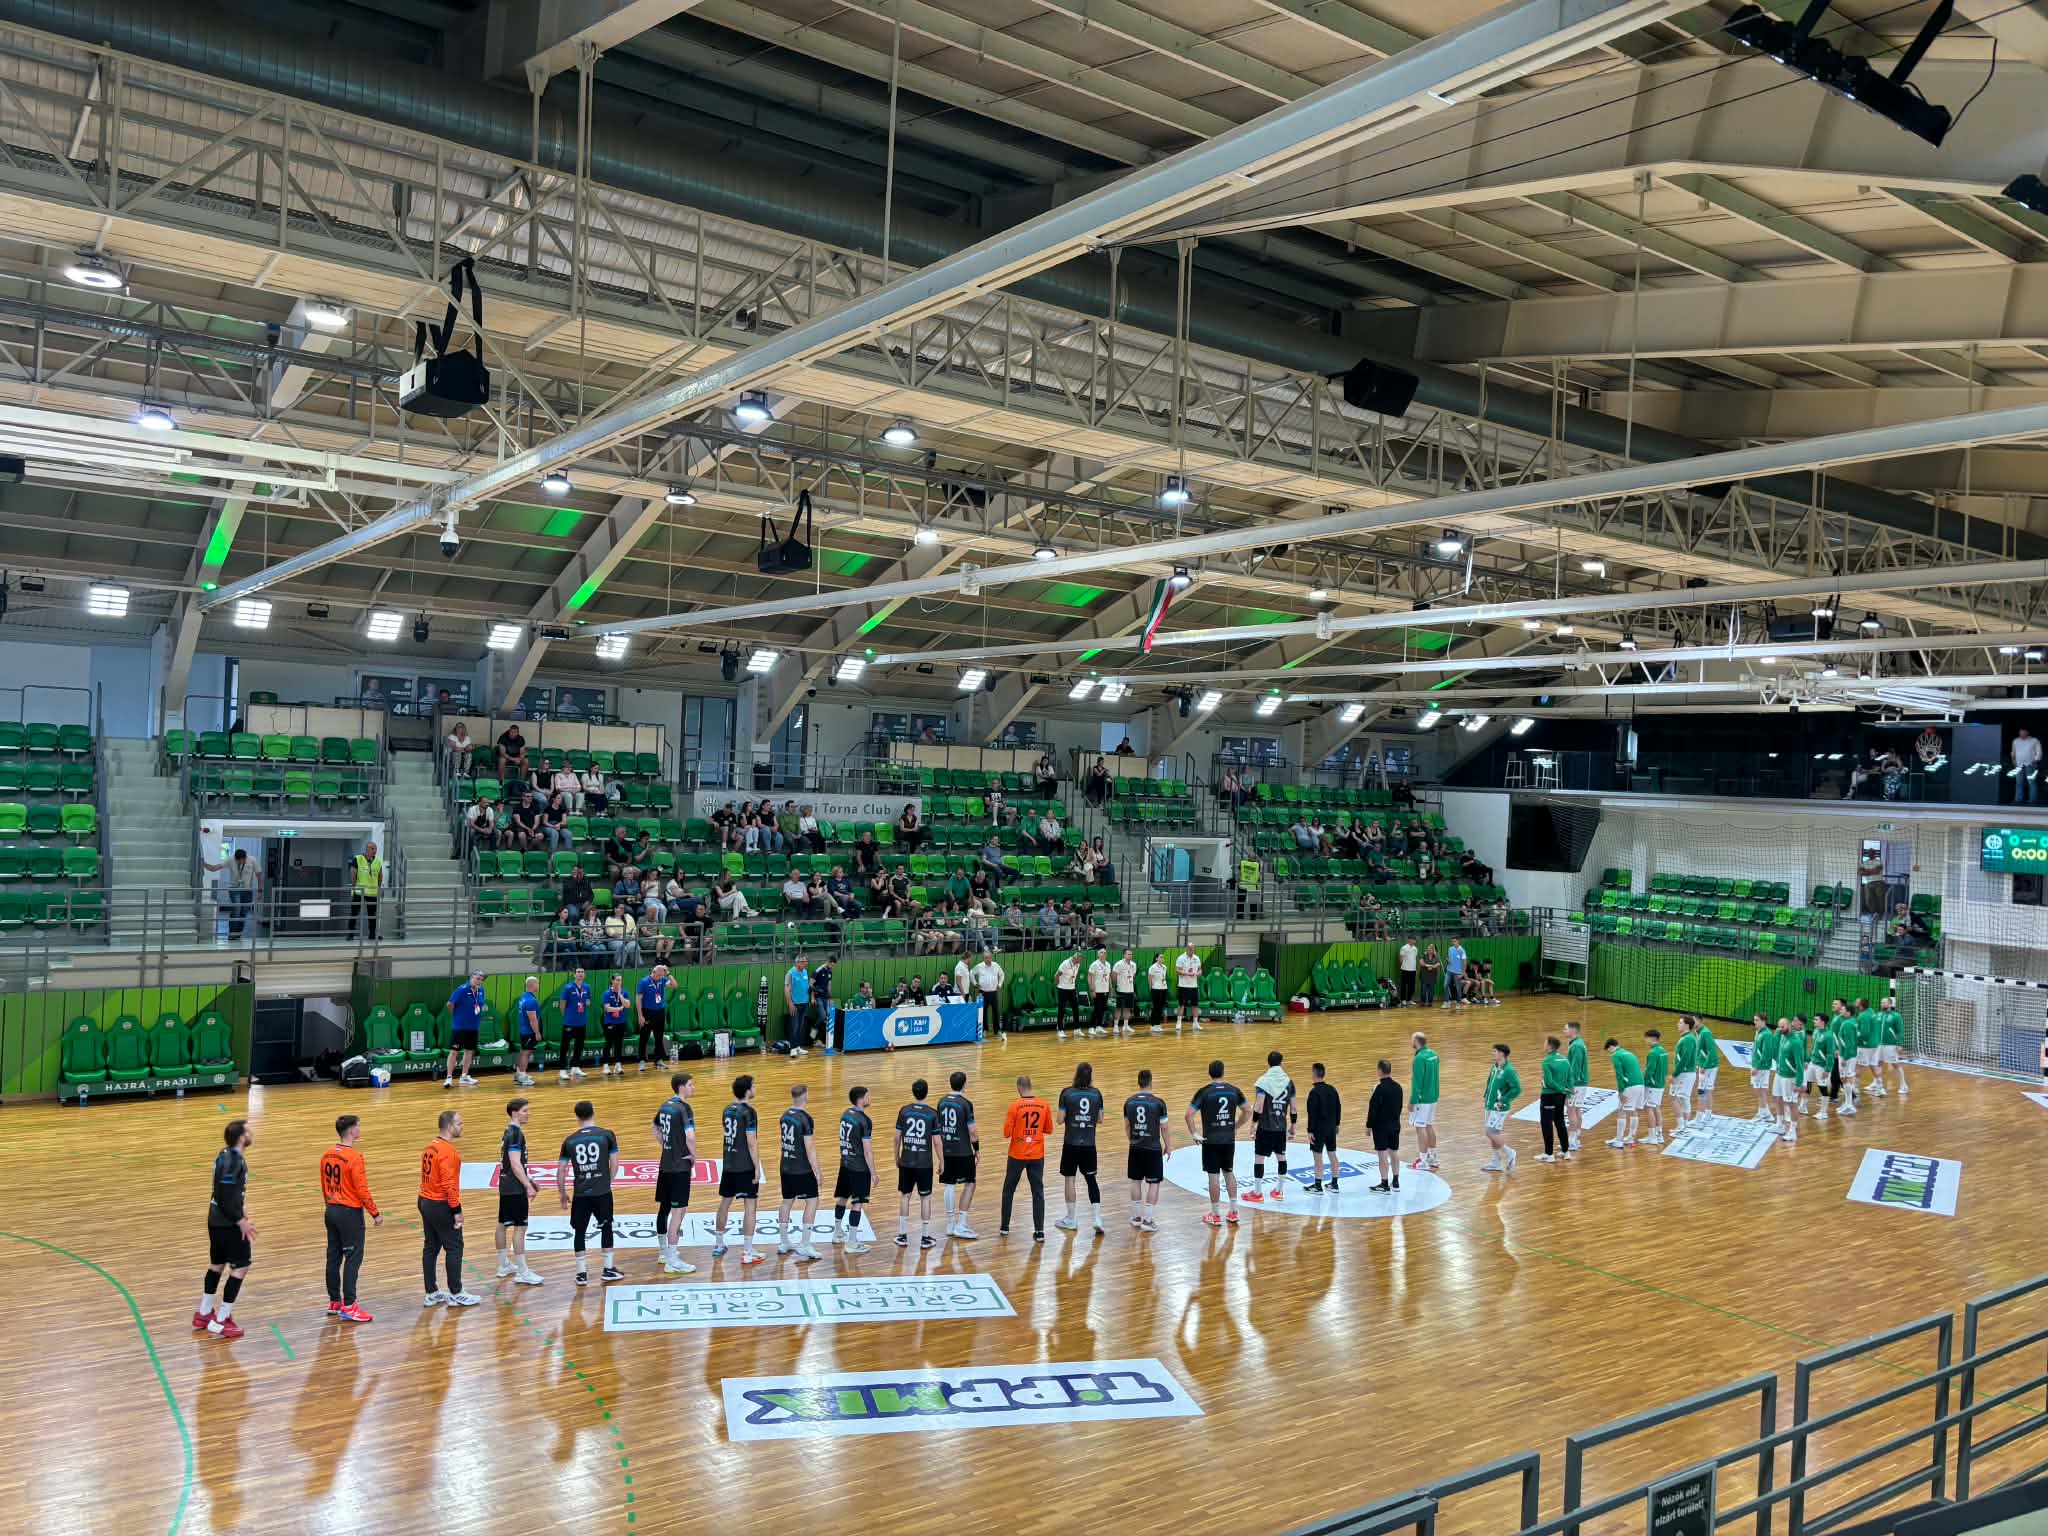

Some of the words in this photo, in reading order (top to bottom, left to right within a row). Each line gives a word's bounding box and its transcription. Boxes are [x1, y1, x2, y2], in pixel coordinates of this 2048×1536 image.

[823, 802, 857, 815] Torna
[863, 804, 891, 815] Club
[2012, 847, 2047, 860] 0:00
[105, 1081, 150, 1092] HAJRÁ,
[156, 1078, 197, 1088] FRADI!
[1079, 1097, 1090, 1115] 9
[1218, 1096, 1228, 1114] 2
[941, 1107, 957, 1127] 19
[1022, 1111, 1040, 1129] 12
[1136, 1106, 1146, 1124] 8
[781, 1122, 794, 1145] 34
[905, 1117, 926, 1138] 29
[575, 1142, 600, 1165] 89
[325, 1162, 341, 1185] 99
[655, 1291, 764, 1302] COLLECT
[853, 1285, 954, 1295] COLLECT
[637, 1300, 785, 1317] GREEN
[836, 1293, 978, 1310] GREEN
